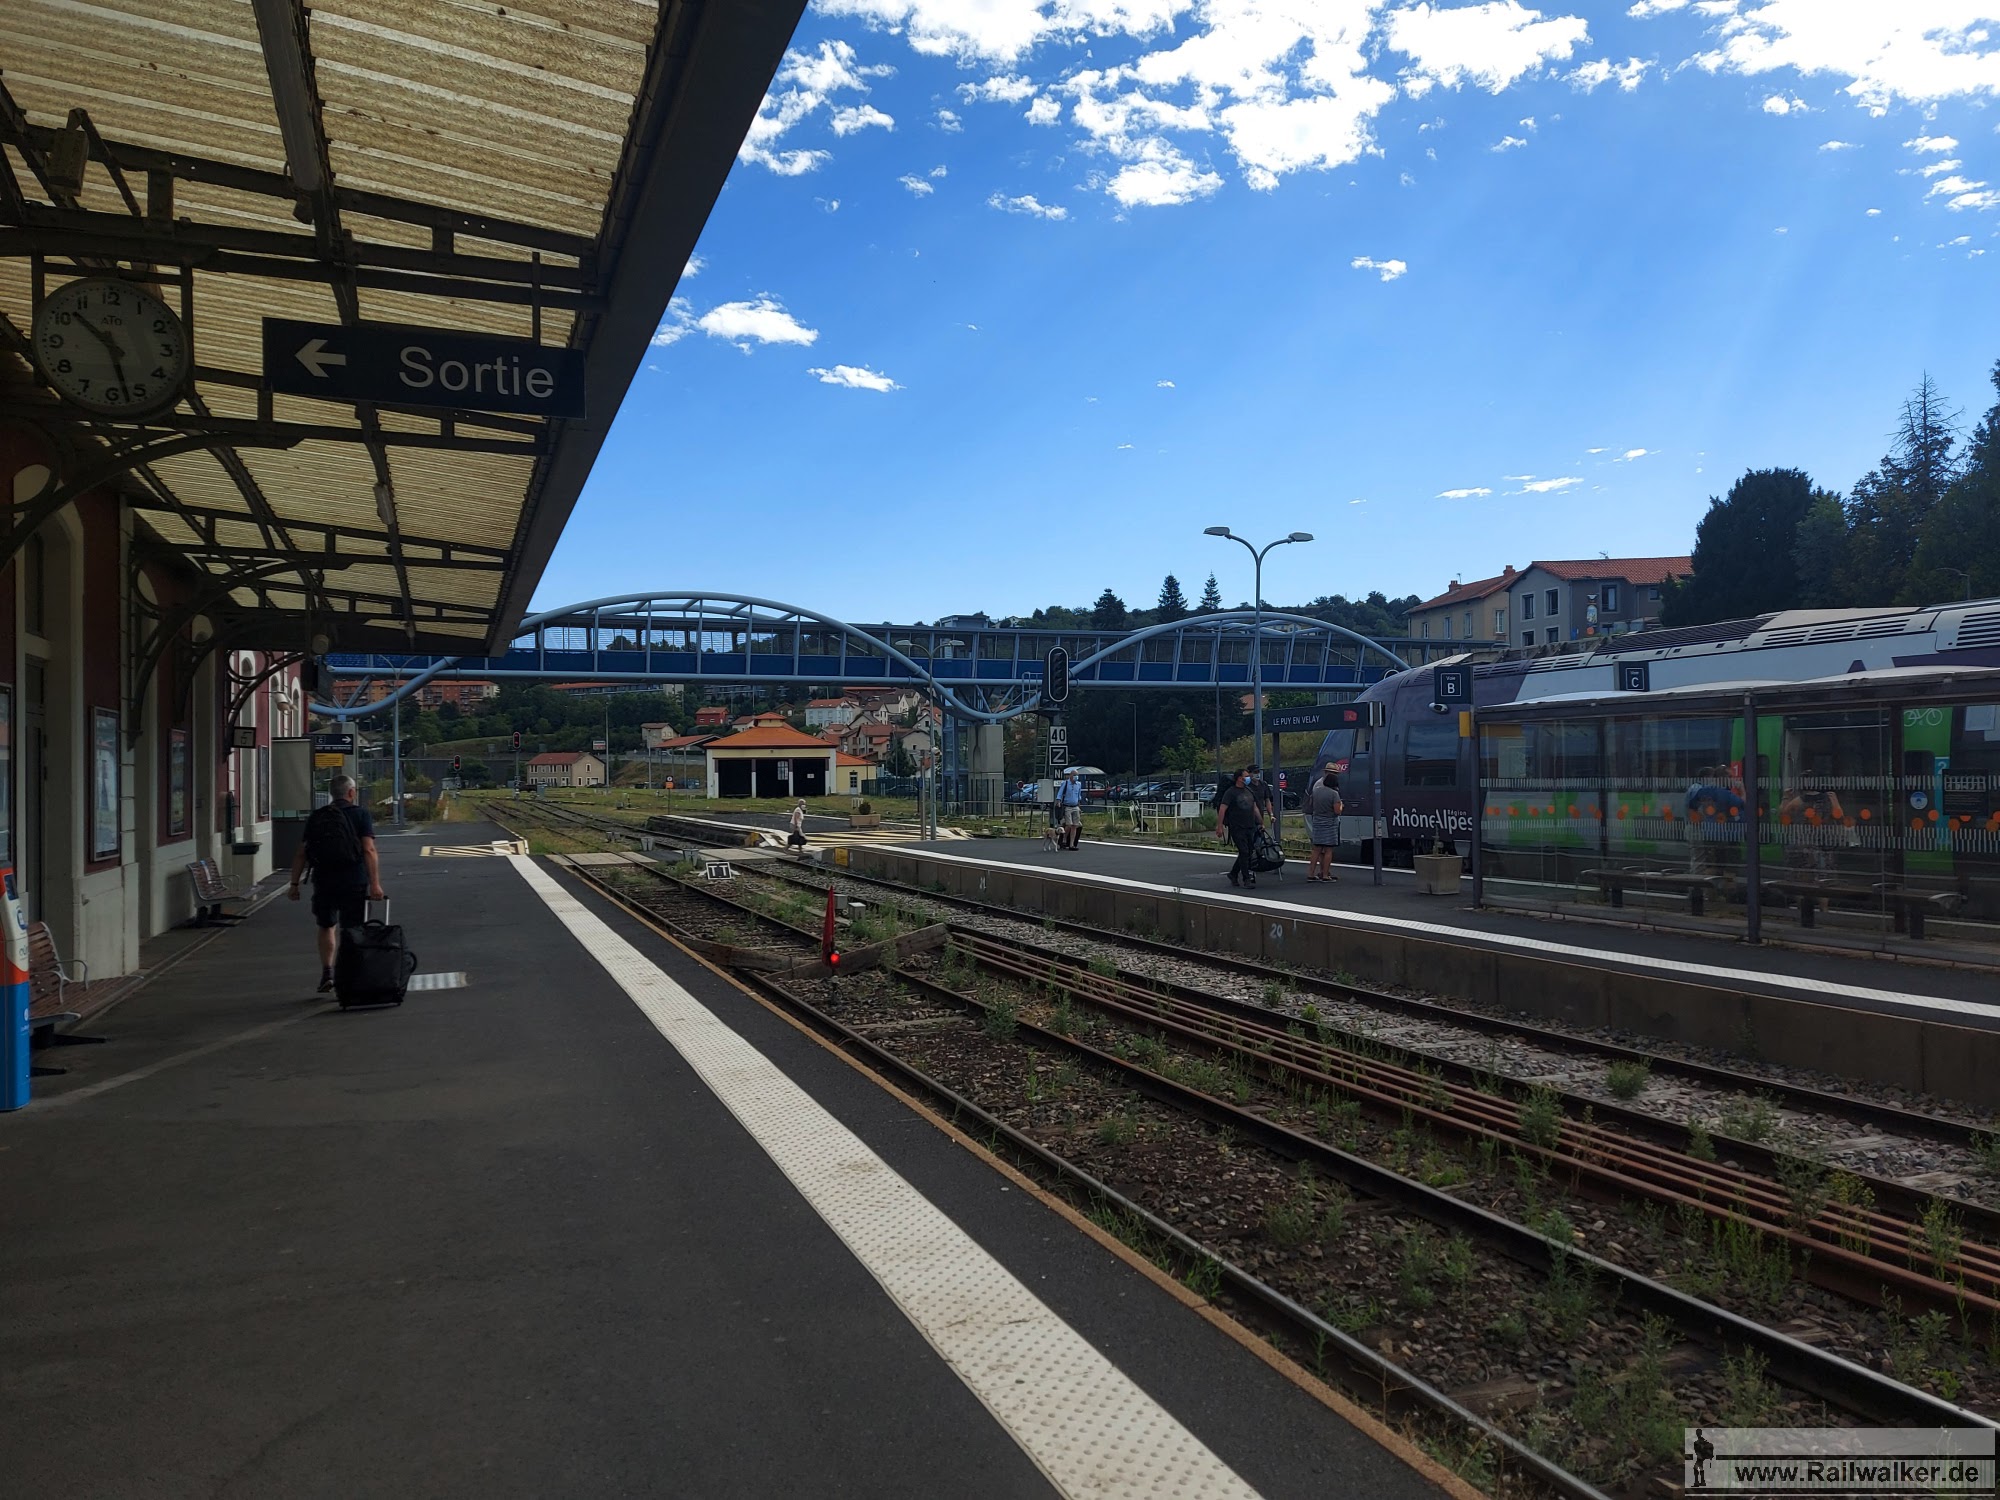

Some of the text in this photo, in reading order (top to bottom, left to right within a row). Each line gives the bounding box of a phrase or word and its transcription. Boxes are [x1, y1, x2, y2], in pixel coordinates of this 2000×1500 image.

[77, 295, 88, 310] 11
[102, 291, 121, 306] 12
[137, 301, 142, 315] 1
[55, 311, 71, 327] 10
[153, 320, 167, 334] 2
[49, 334, 64, 349] 9
[160, 344, 173, 357] 3
[57, 359, 72, 374] 8
[151, 366, 167, 379] 4
[399, 346, 554, 398] Sortie
[78, 379, 90, 393] 7
[133, 384, 146, 397] 5
[105, 387, 119, 401] 6
[1447, 682, 1455, 694] B
[1631, 677, 1640, 688] C
[1273, 714, 1320, 726] LE PUY EN VELAY
[1051, 728, 1066, 742] 40
[1052, 748, 1065, 763] Z
[1270, 922, 1283, 939] 20
